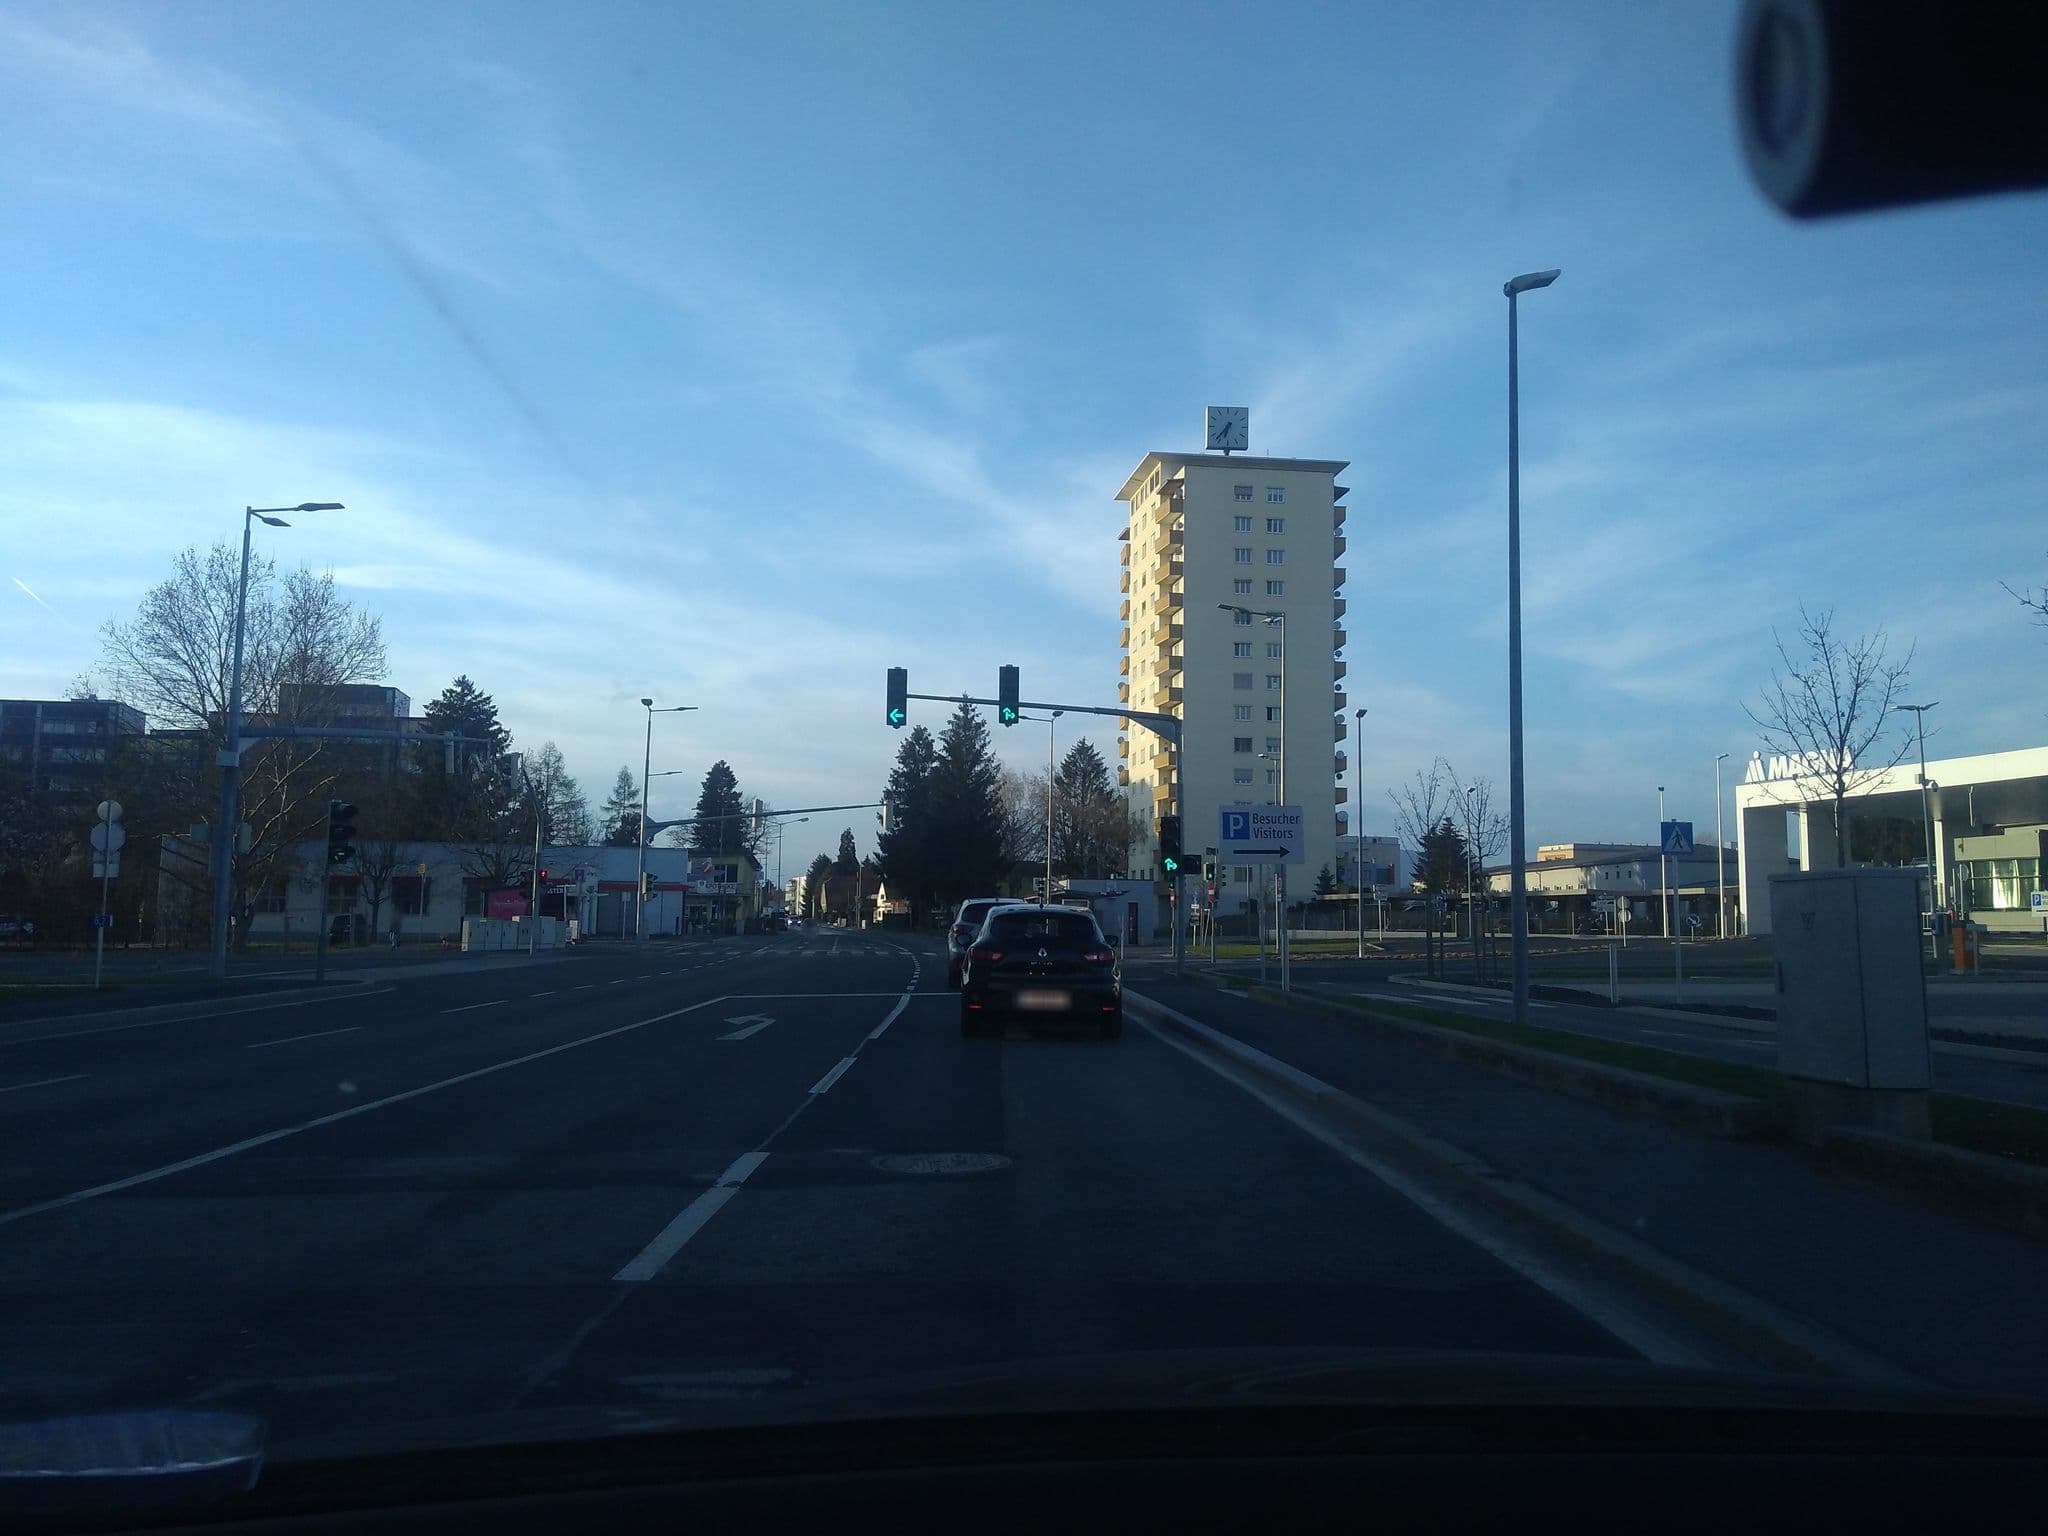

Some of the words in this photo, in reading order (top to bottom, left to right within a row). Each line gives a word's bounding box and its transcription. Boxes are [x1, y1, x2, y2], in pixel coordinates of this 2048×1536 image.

[1253, 813, 1300, 825] Besucher
[1229, 814, 1244, 838] P
[1253, 827, 1294, 839] Visitors
